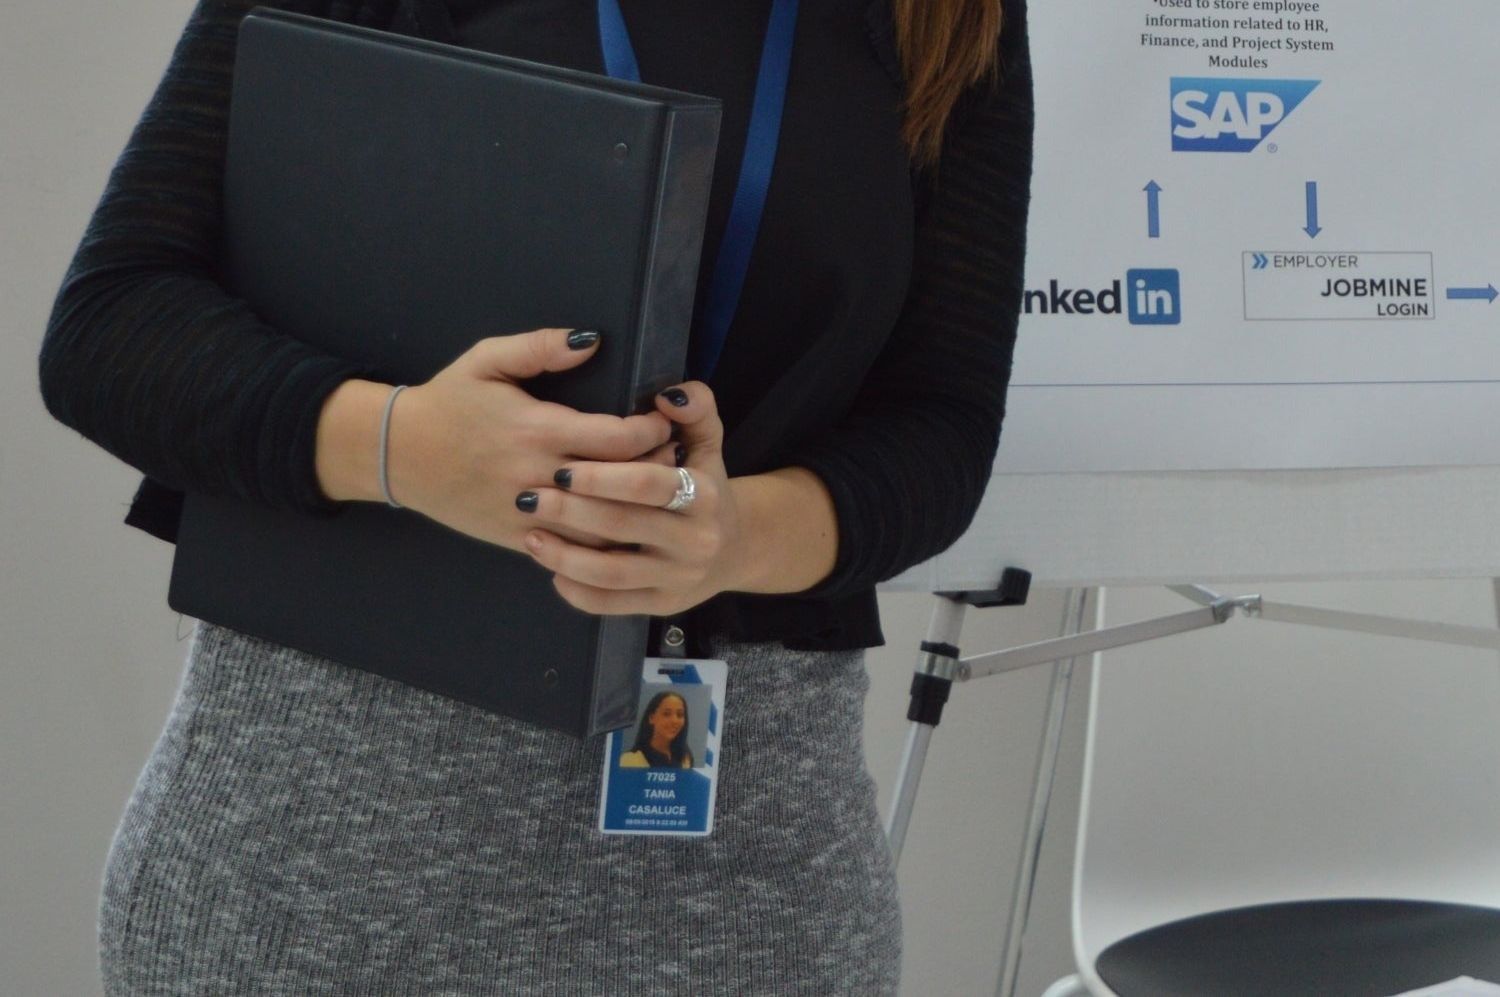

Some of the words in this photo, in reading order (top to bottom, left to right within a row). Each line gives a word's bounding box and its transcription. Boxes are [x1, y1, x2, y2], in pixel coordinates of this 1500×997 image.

[1145, 13, 1229, 29] information
[1233, 16, 1283, 30] related
[1286, 19, 1301, 31] to
[1304, 18, 1328, 33] HR,
[1140, 33, 1199, 49] Finance,
[1201, 35, 1228, 48] and
[1231, 35, 1282, 52] Project
[1285, 37, 1334, 53] System
[1208, 54, 1268, 69] Modules
[1171, 89, 1285, 141] SAP
[1272, 254, 1358, 268] EMPLOYER
[1320, 277, 1427, 297] JOBMINE
[1023, 278, 1122, 315] nked
[1376, 302, 1428, 317] LOGIN
[644, 788, 676, 799] TANIA
[628, 804, 686, 816] CASALUCE
